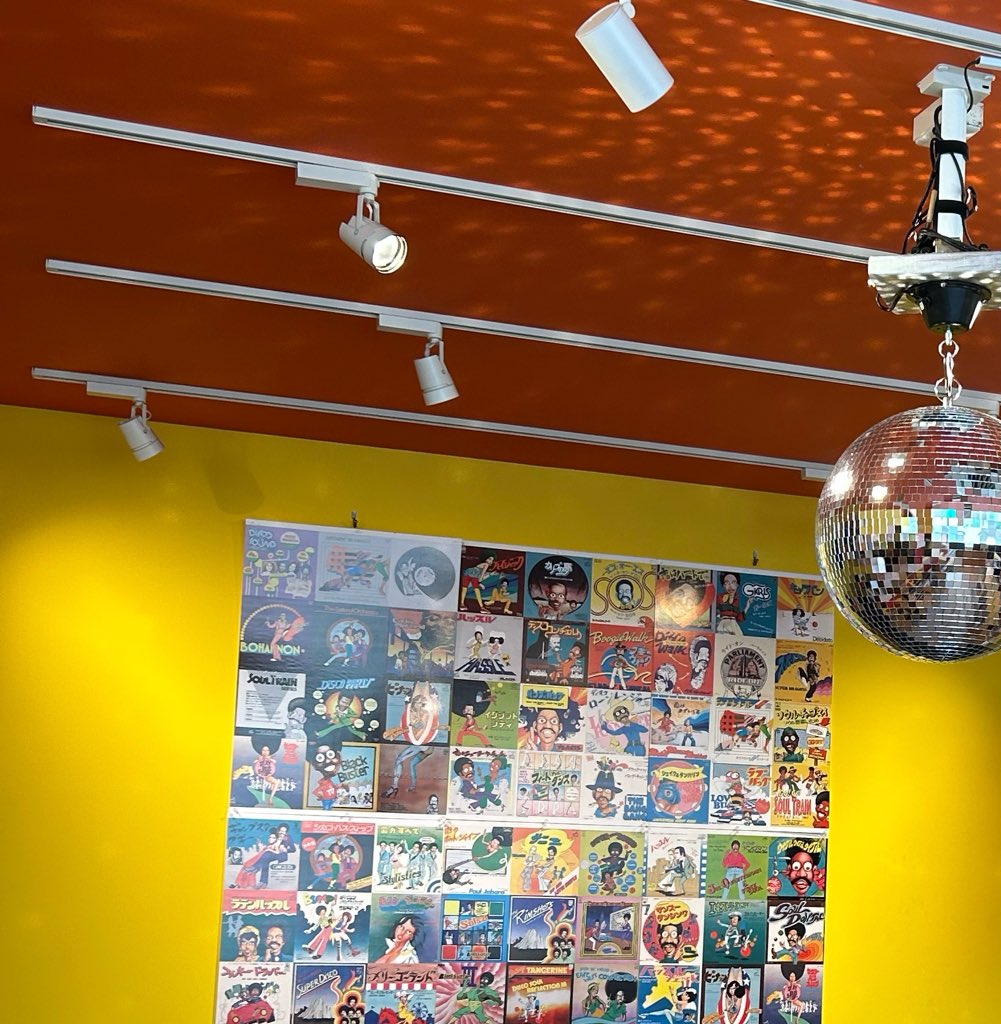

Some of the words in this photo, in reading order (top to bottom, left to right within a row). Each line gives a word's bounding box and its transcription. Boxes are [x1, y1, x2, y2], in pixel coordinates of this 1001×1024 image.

[724, 648, 765, 669] PARLIAMENT
[341, 755, 368, 771] Black
[337, 765, 369, 783] Buster
[527, 966, 568, 974] TANGERINE
